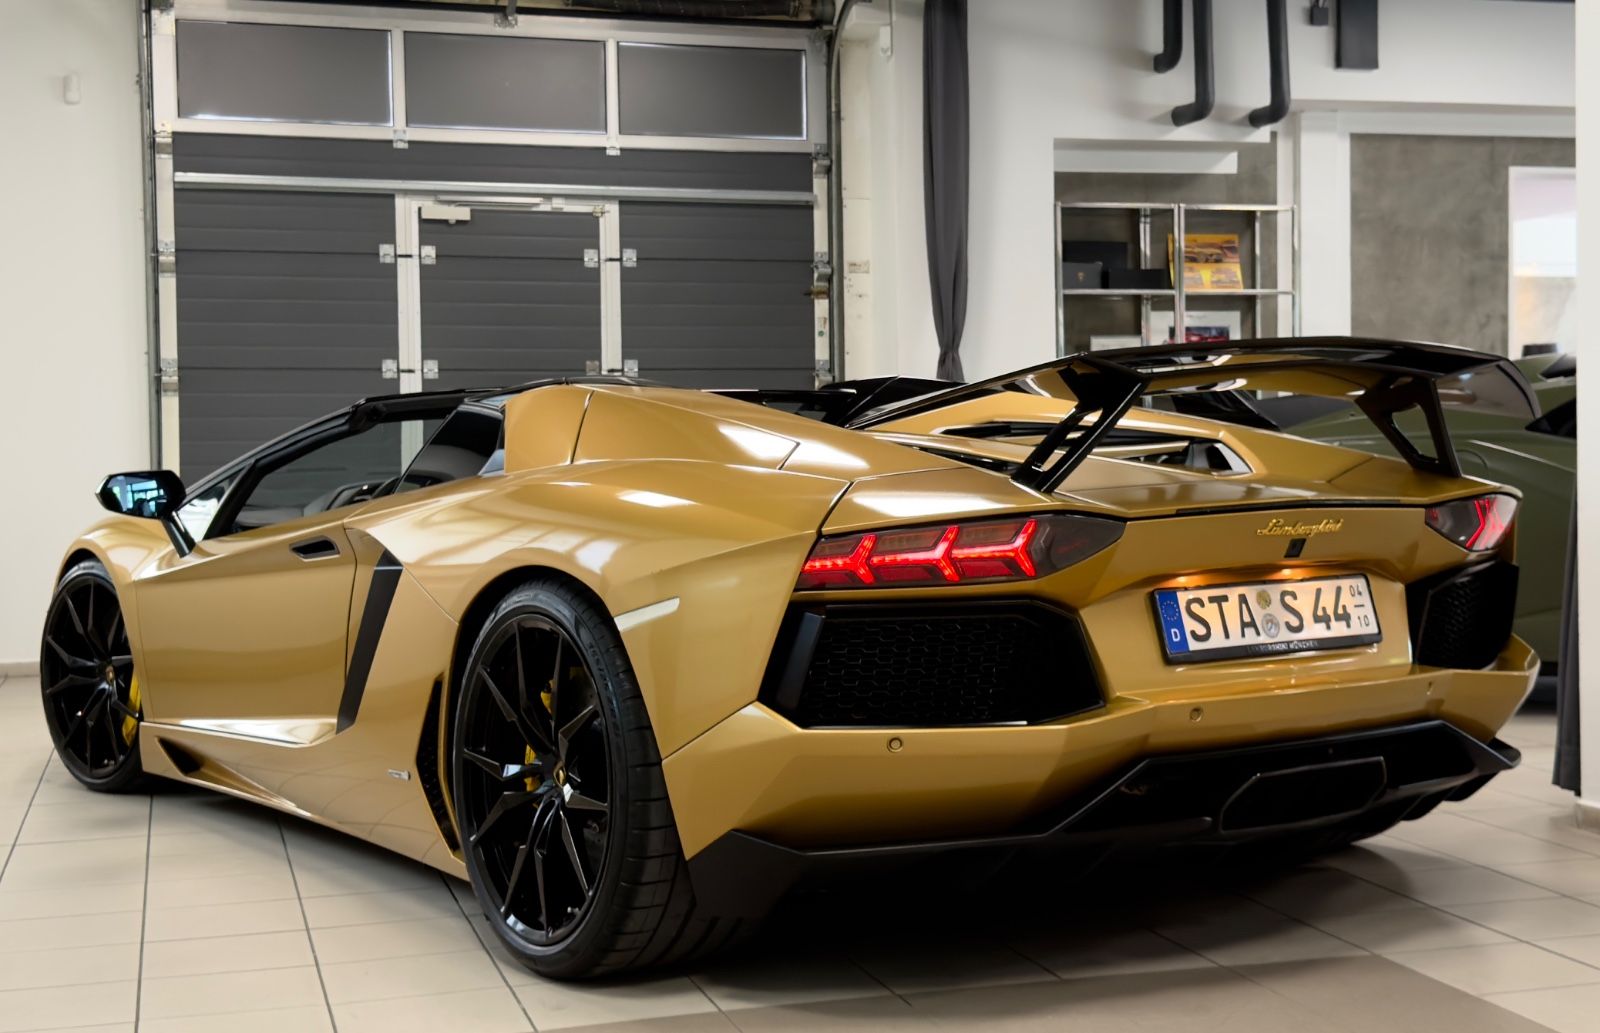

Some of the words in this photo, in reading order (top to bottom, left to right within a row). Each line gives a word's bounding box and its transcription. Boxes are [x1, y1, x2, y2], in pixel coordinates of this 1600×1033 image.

[1257, 519, 1344, 537] Lamborghini
[1349, 584, 1363, 598] 04
[1185, 593, 1261, 642] STA
[1279, 590, 1304, 634] S
[1312, 585, 1351, 631] 44
[1357, 614, 1370, 628] 10
[1171, 628, 1181, 642] D
